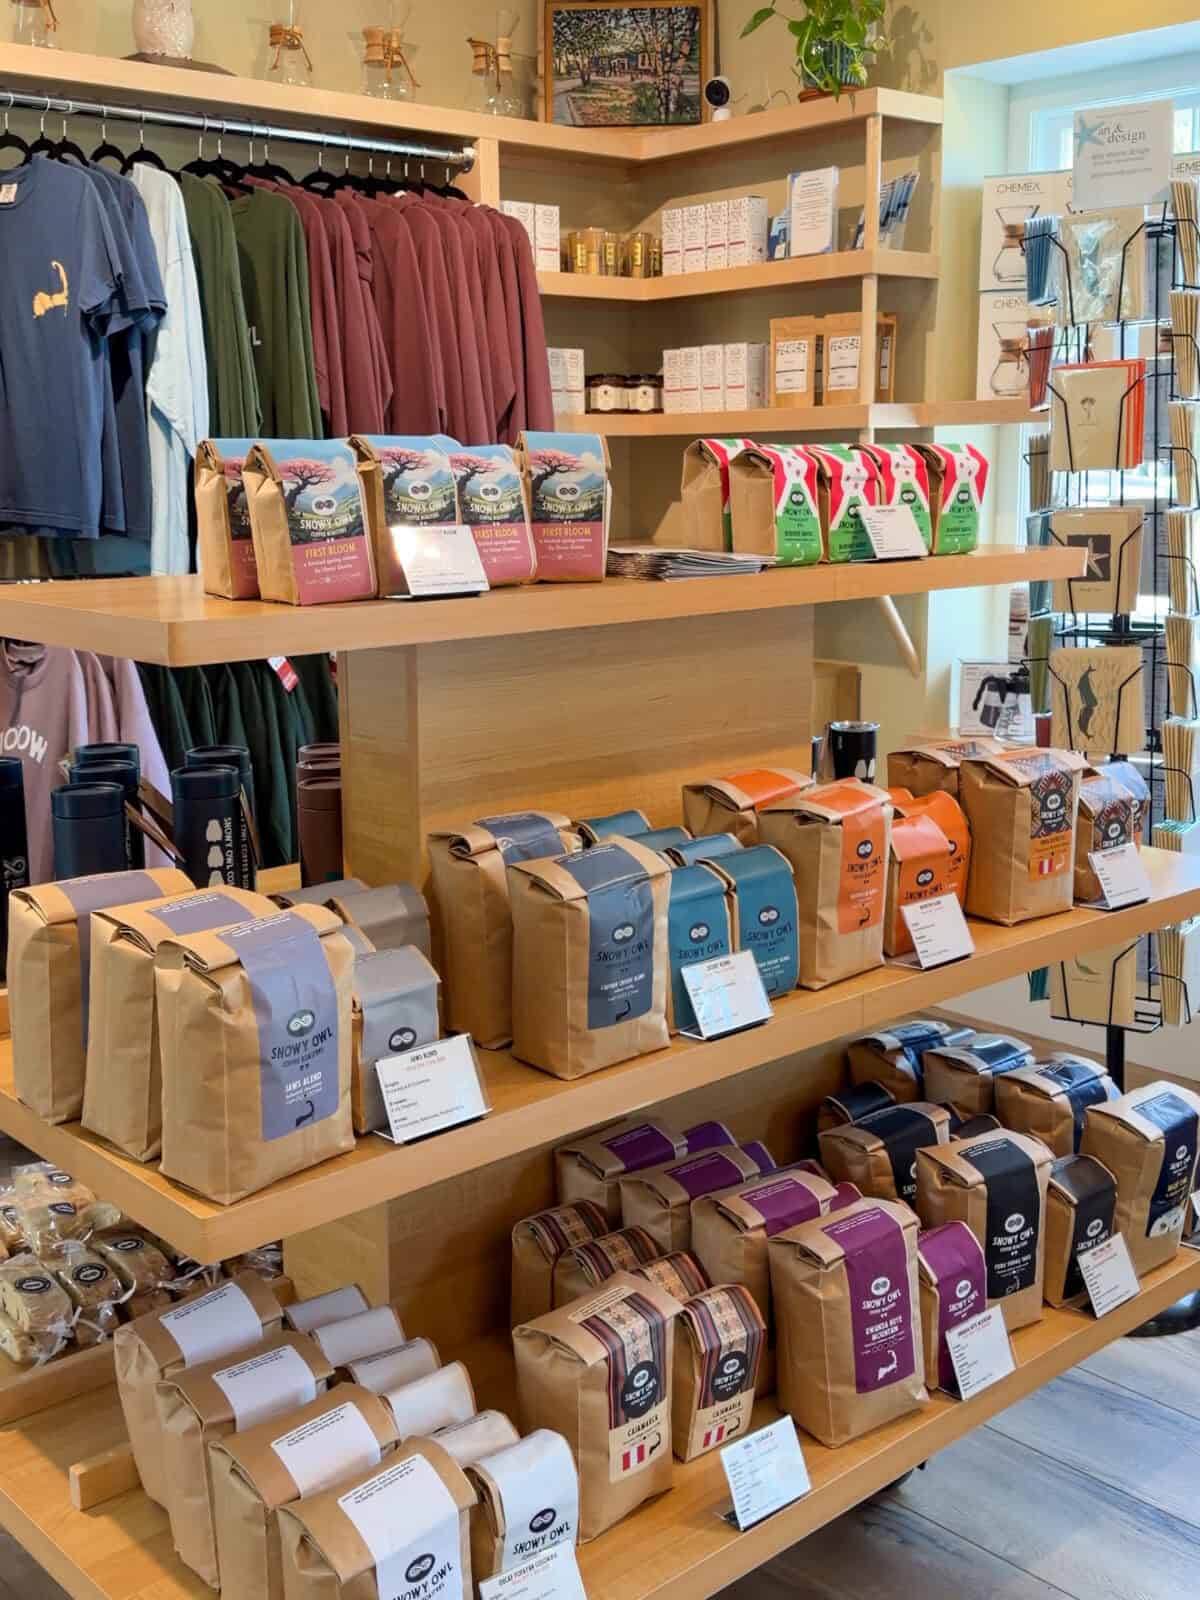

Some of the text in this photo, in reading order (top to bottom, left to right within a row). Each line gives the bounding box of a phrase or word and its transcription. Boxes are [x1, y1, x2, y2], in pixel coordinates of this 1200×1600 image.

[1107, 129, 1146, 145] design
[300, 518, 333, 529] SNOWY
[495, 527, 518, 537] BLOOM
[543, 527, 591, 537] FIRST BLOOM
[305, 543, 356, 558] FIRST BLOOM
[224, 817, 233, 847] SNOWY
[225, 850, 233, 870] OWL
[271, 1027, 333, 1060] SNOWY OWL
[992, 1234, 1019, 1247] SNOWY
[862, 1288, 902, 1310] SNOWY OWL
[512, 1521, 571, 1556] SNOWY OWL
[432, 1562, 453, 1586] OWL
